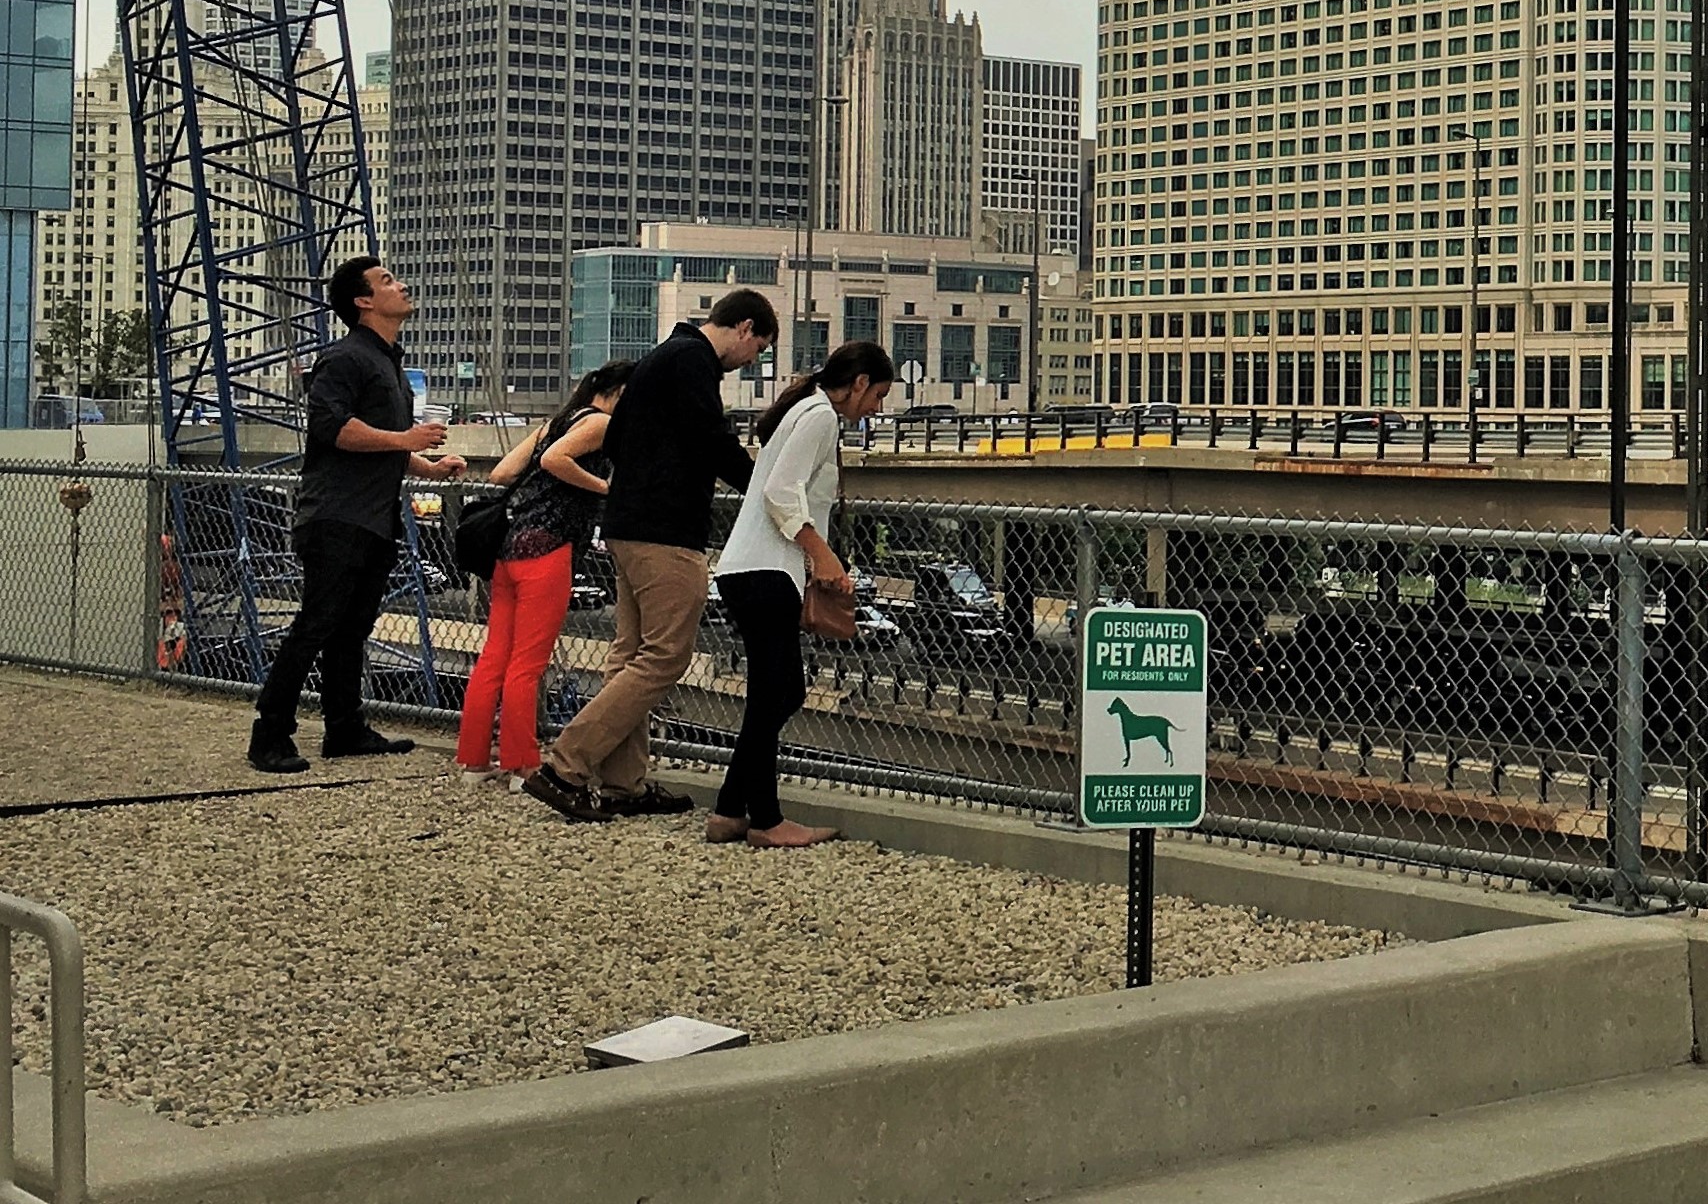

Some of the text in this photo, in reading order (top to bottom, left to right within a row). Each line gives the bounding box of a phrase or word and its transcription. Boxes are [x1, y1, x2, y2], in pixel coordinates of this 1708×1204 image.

[1103, 621, 1189, 639] DESIGNATED
[1096, 641, 1196, 668] PET AREA
[1102, 670, 1189, 682] FOR RESIDENTS ONLY
[1093, 784, 1195, 798] PLEASE CLEAN UP
[1096, 798, 1191, 813] AFTER YOUR PET
